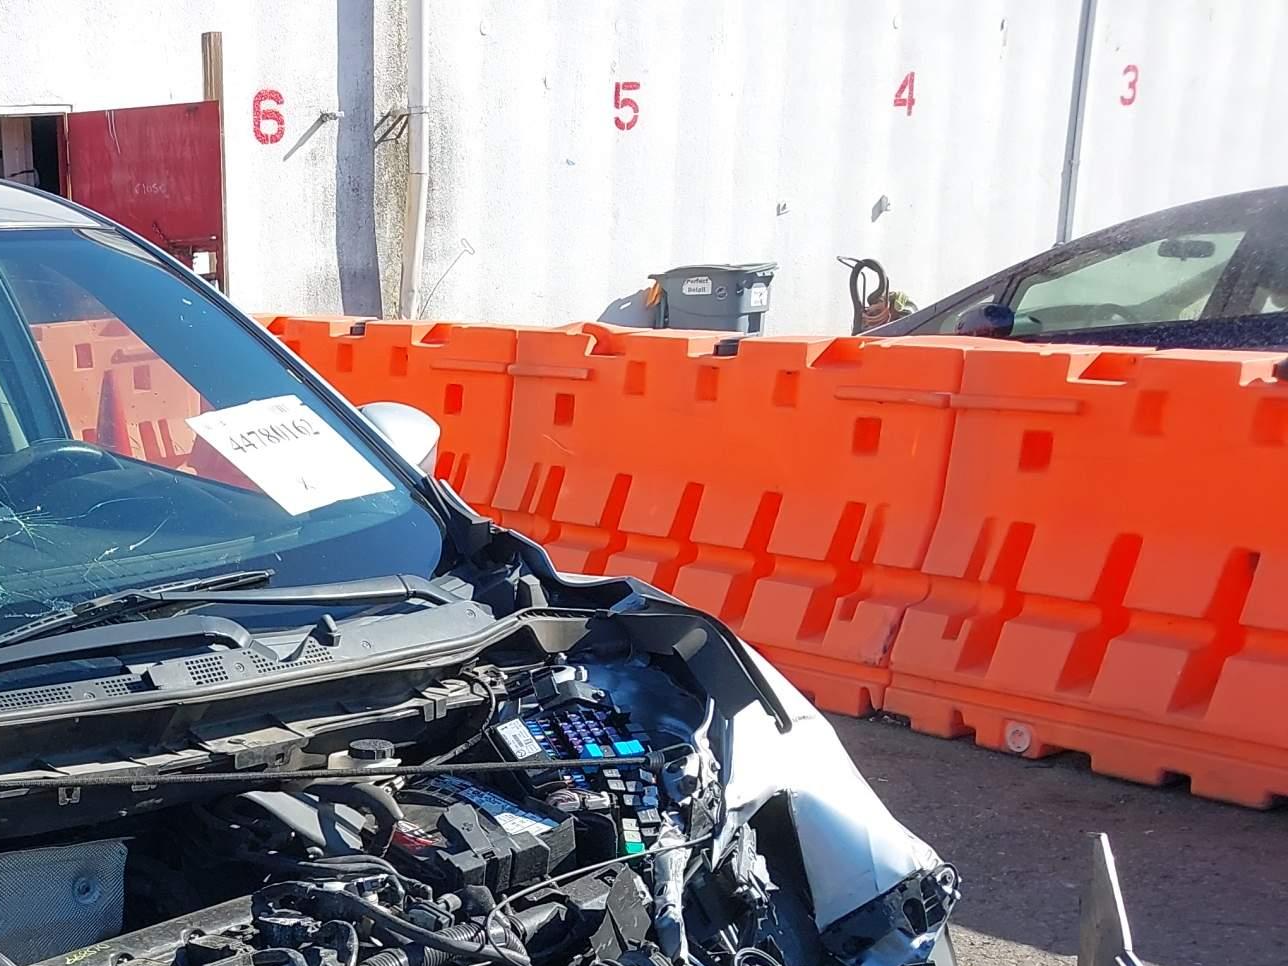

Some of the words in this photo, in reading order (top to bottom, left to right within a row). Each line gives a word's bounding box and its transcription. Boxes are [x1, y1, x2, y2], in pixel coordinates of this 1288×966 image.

[613, 81, 641, 131] 5
[893, 71, 916, 116] 4
[1119, 64, 1139, 106] 3
[252, 89, 285, 144] 6
[228, 417, 320, 453] 44780162
